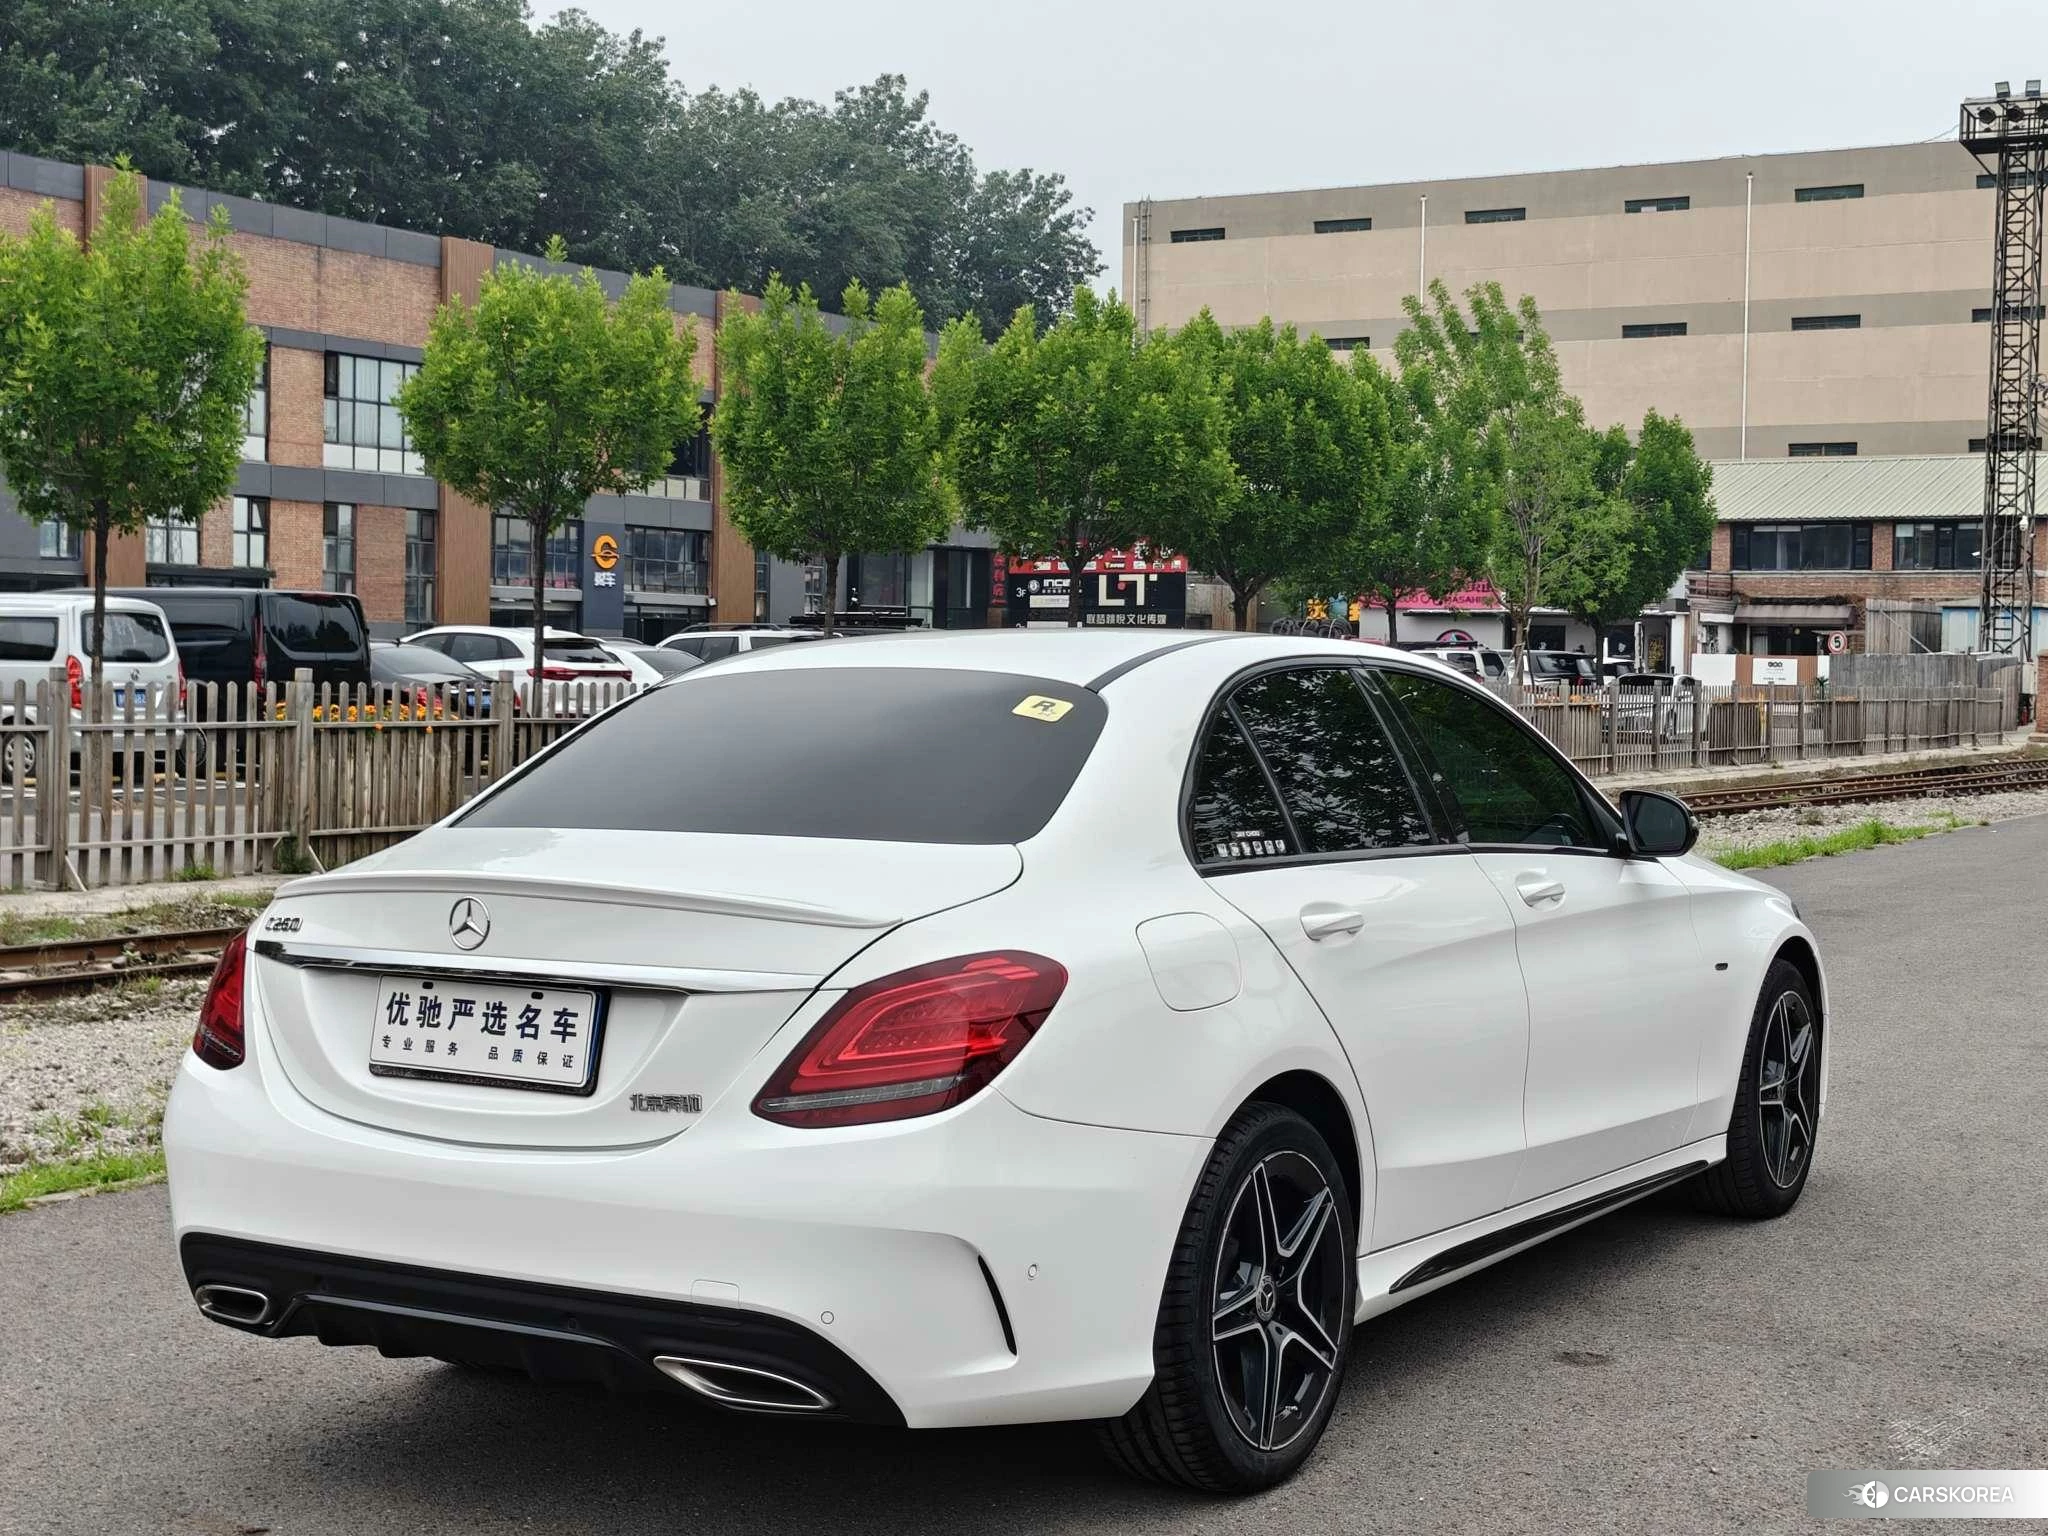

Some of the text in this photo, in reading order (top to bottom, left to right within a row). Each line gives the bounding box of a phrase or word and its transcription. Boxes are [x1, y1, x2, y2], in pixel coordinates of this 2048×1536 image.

[1834, 636, 1841, 649] 5
[386, 991, 579, 1044] 优驰严选名车
[382, 1034, 574, 1069] 专业服务 品质保证
